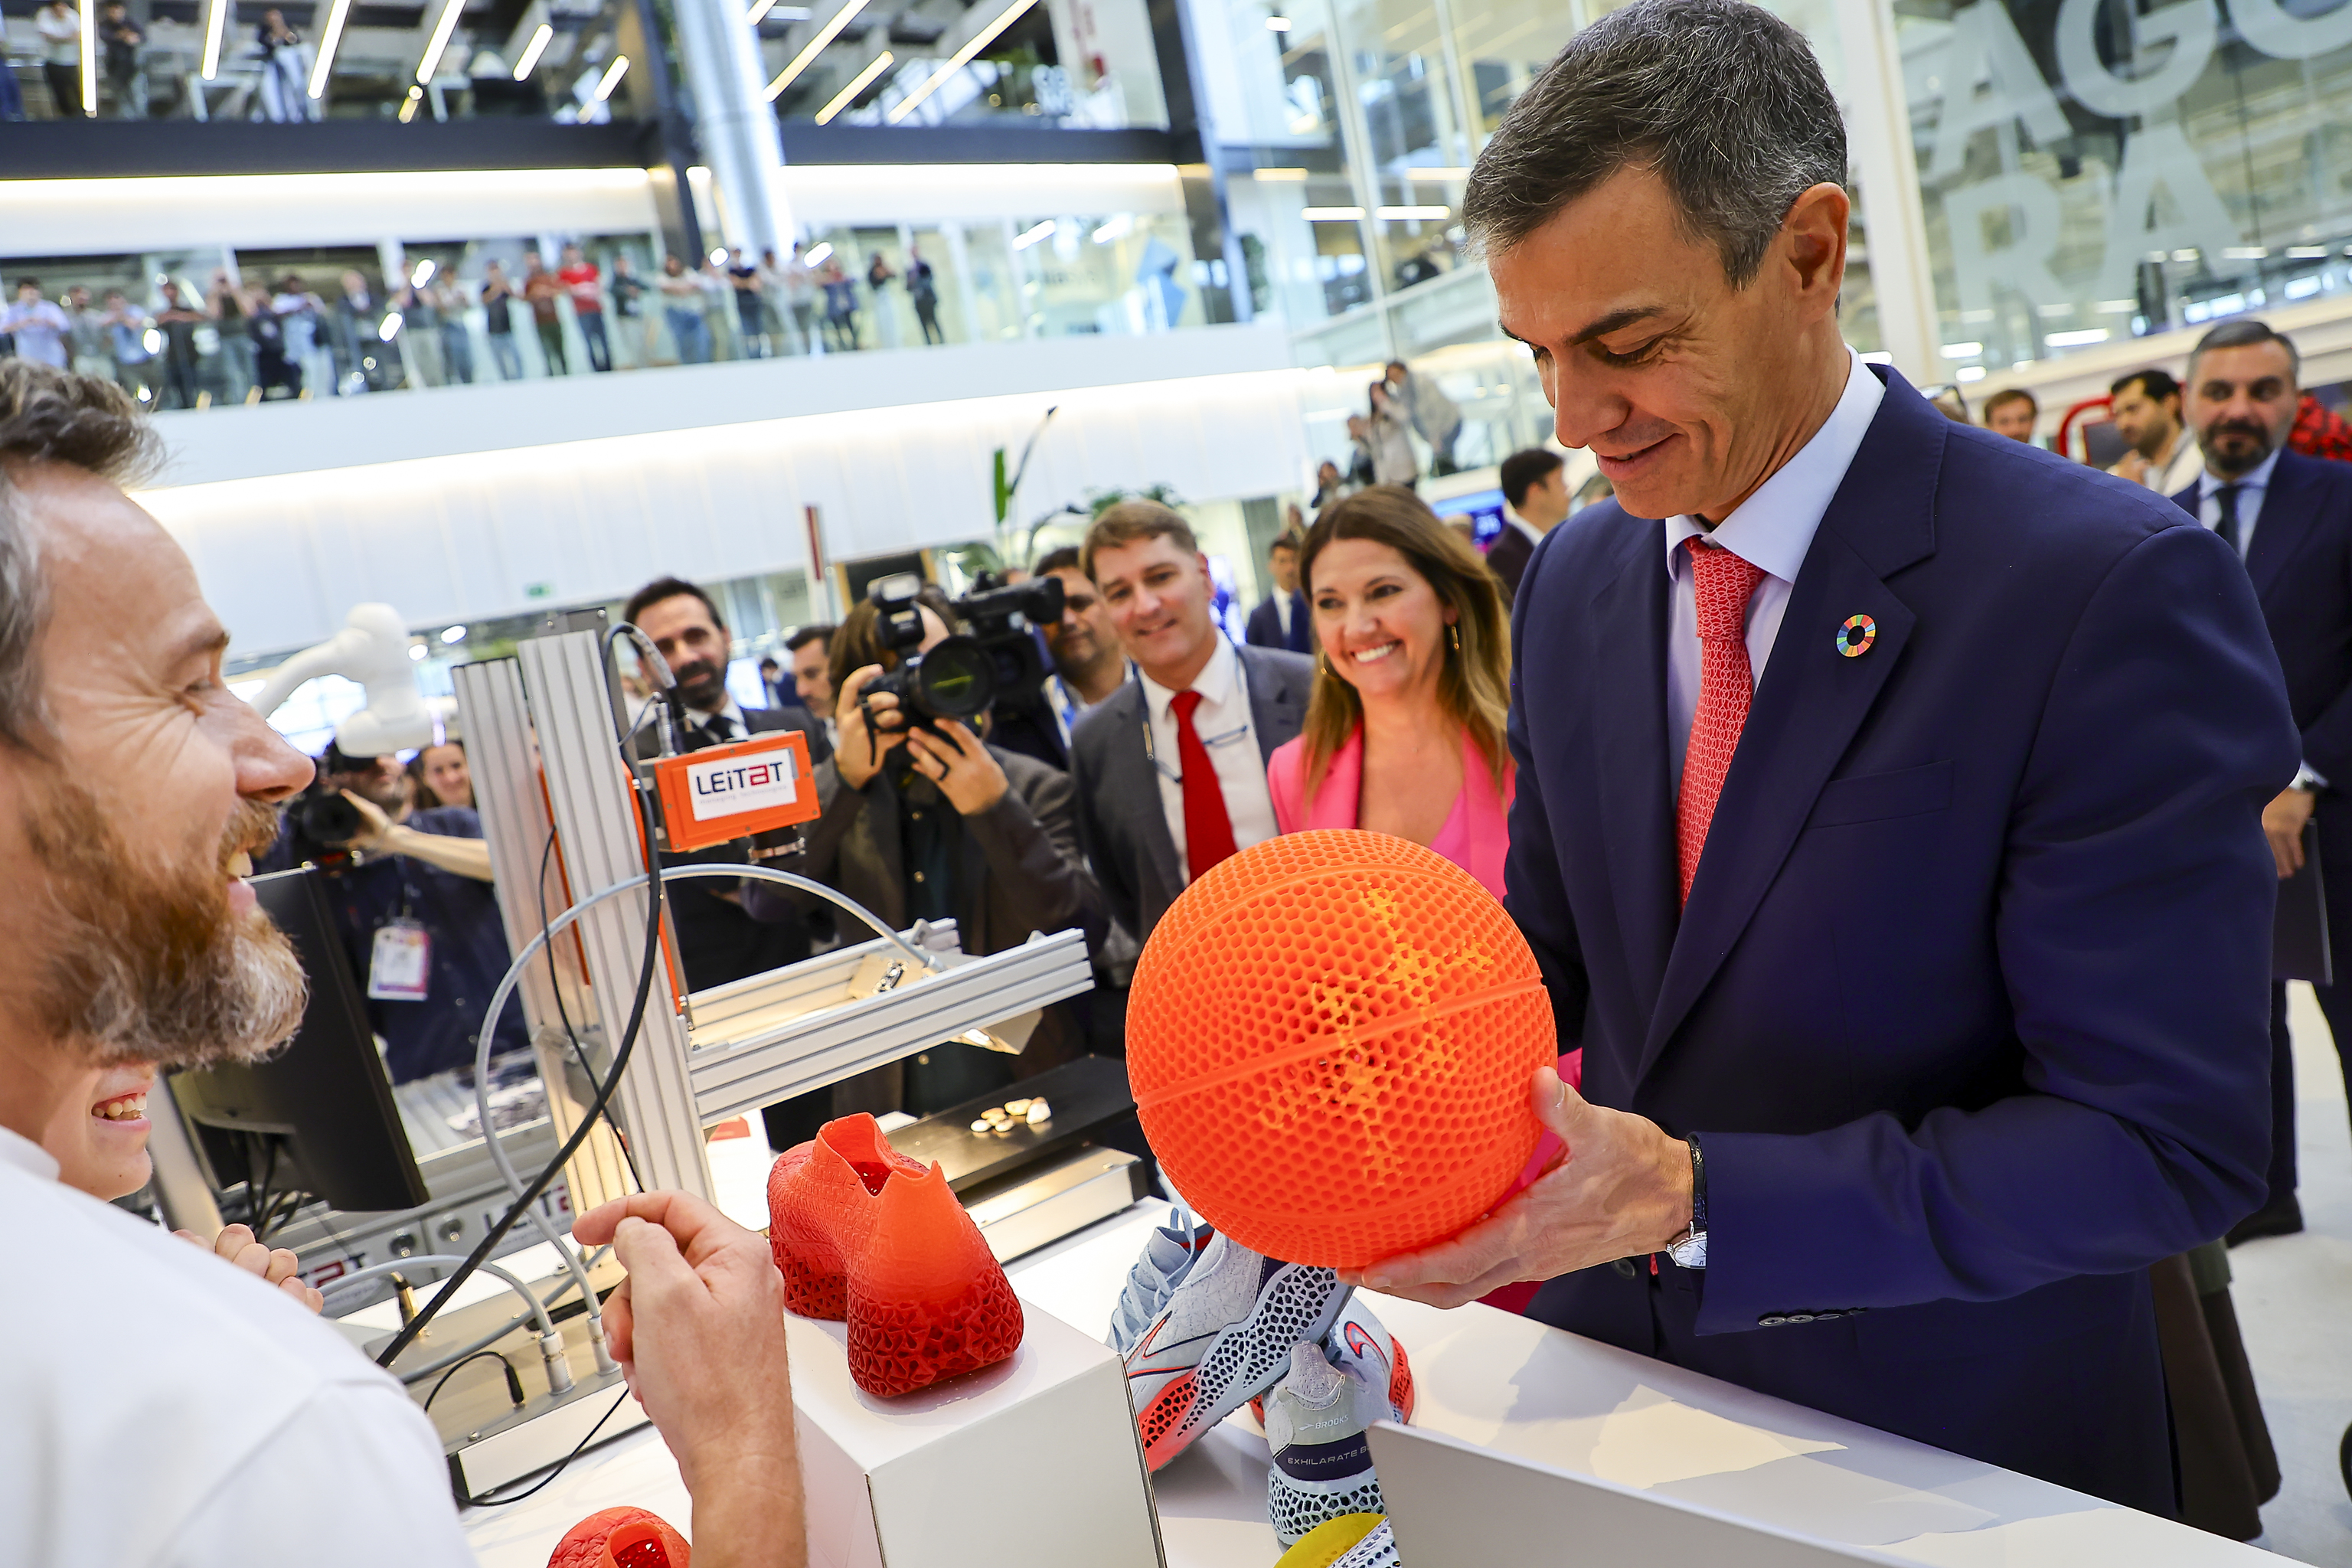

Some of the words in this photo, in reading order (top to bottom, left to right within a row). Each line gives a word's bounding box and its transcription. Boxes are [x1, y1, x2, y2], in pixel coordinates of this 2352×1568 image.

[1945, 121, 2259, 323] RA
[1315, 1414, 1348, 1429] BROOKS
[1287, 1449, 1357, 1465] EXHILARATE
